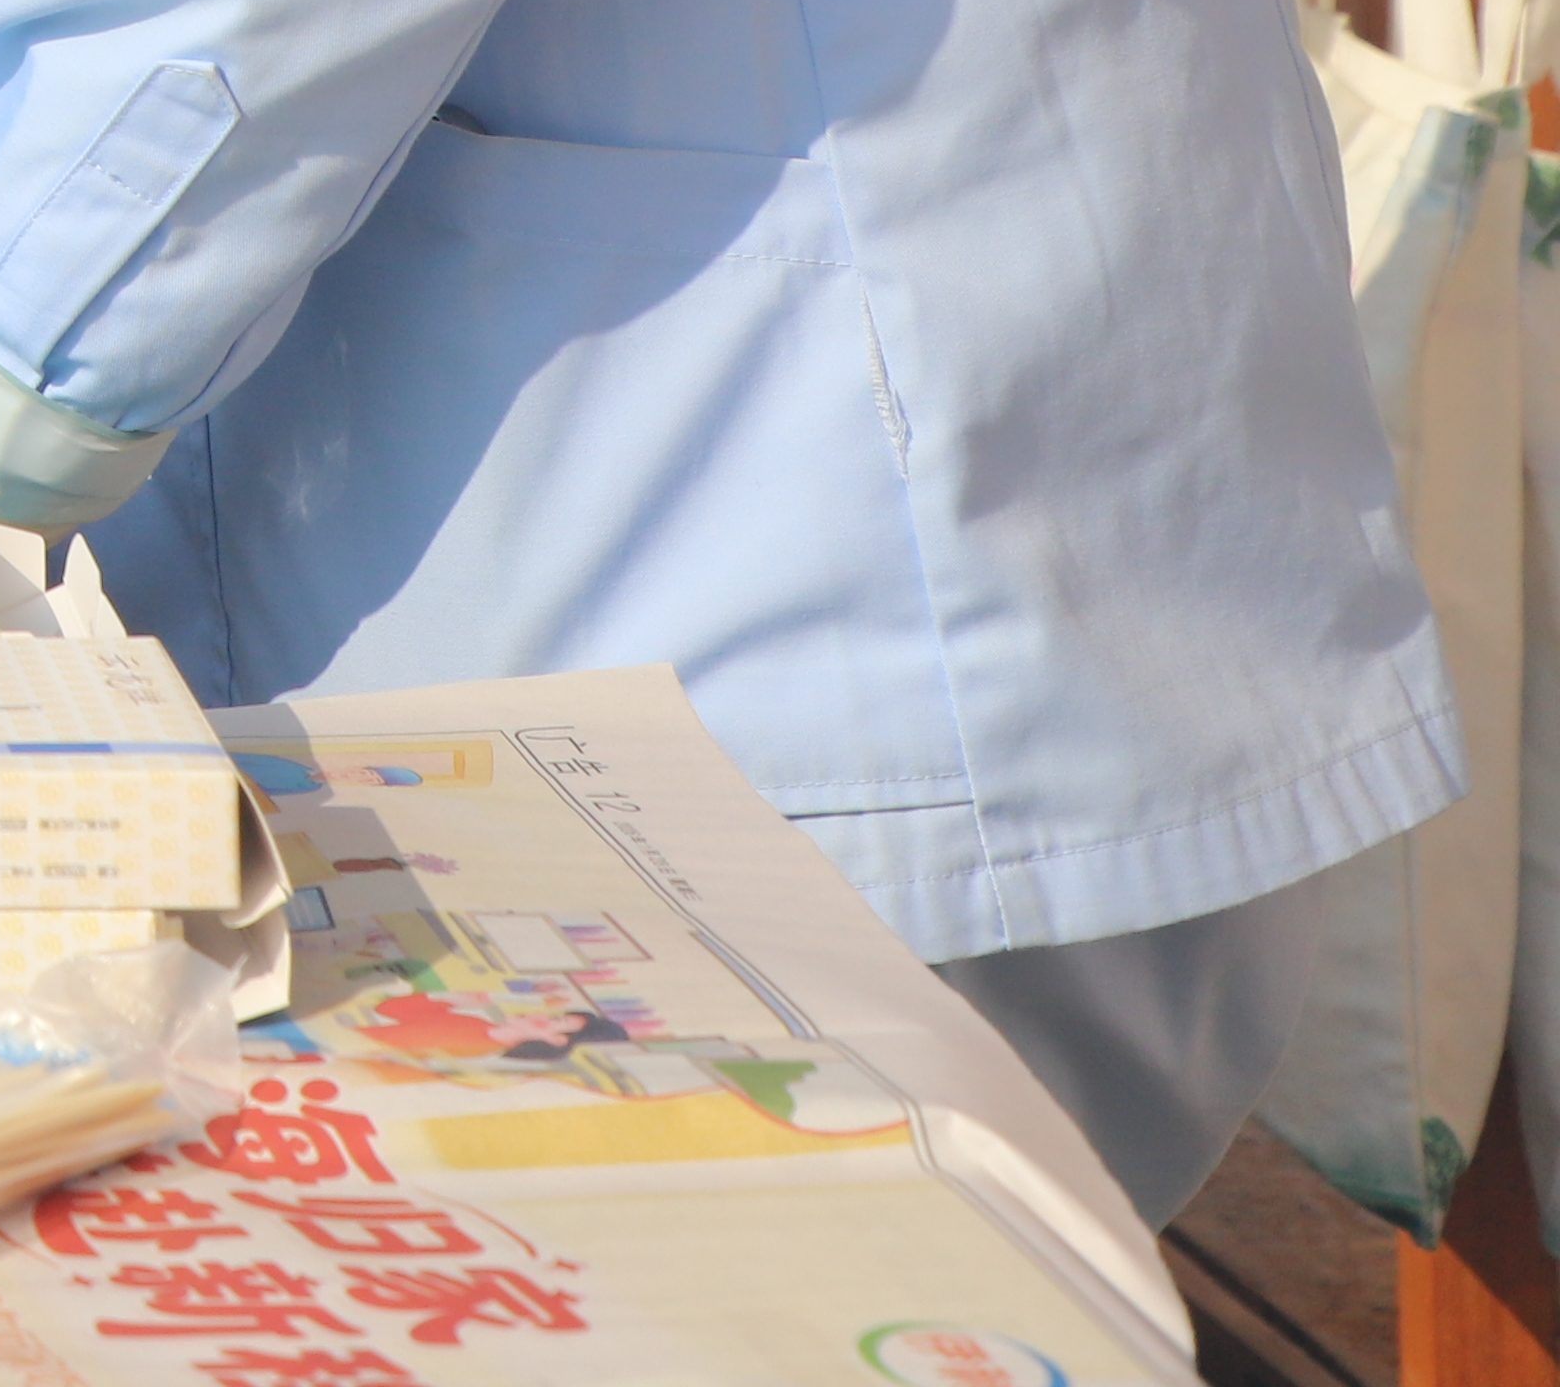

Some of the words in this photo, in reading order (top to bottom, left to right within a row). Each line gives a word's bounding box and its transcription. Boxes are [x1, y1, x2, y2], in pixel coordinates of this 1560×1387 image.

[525, 735, 610, 777] 广告
[585, 791, 643, 813] 12
[178, 1051, 590, 1347] 海归家
